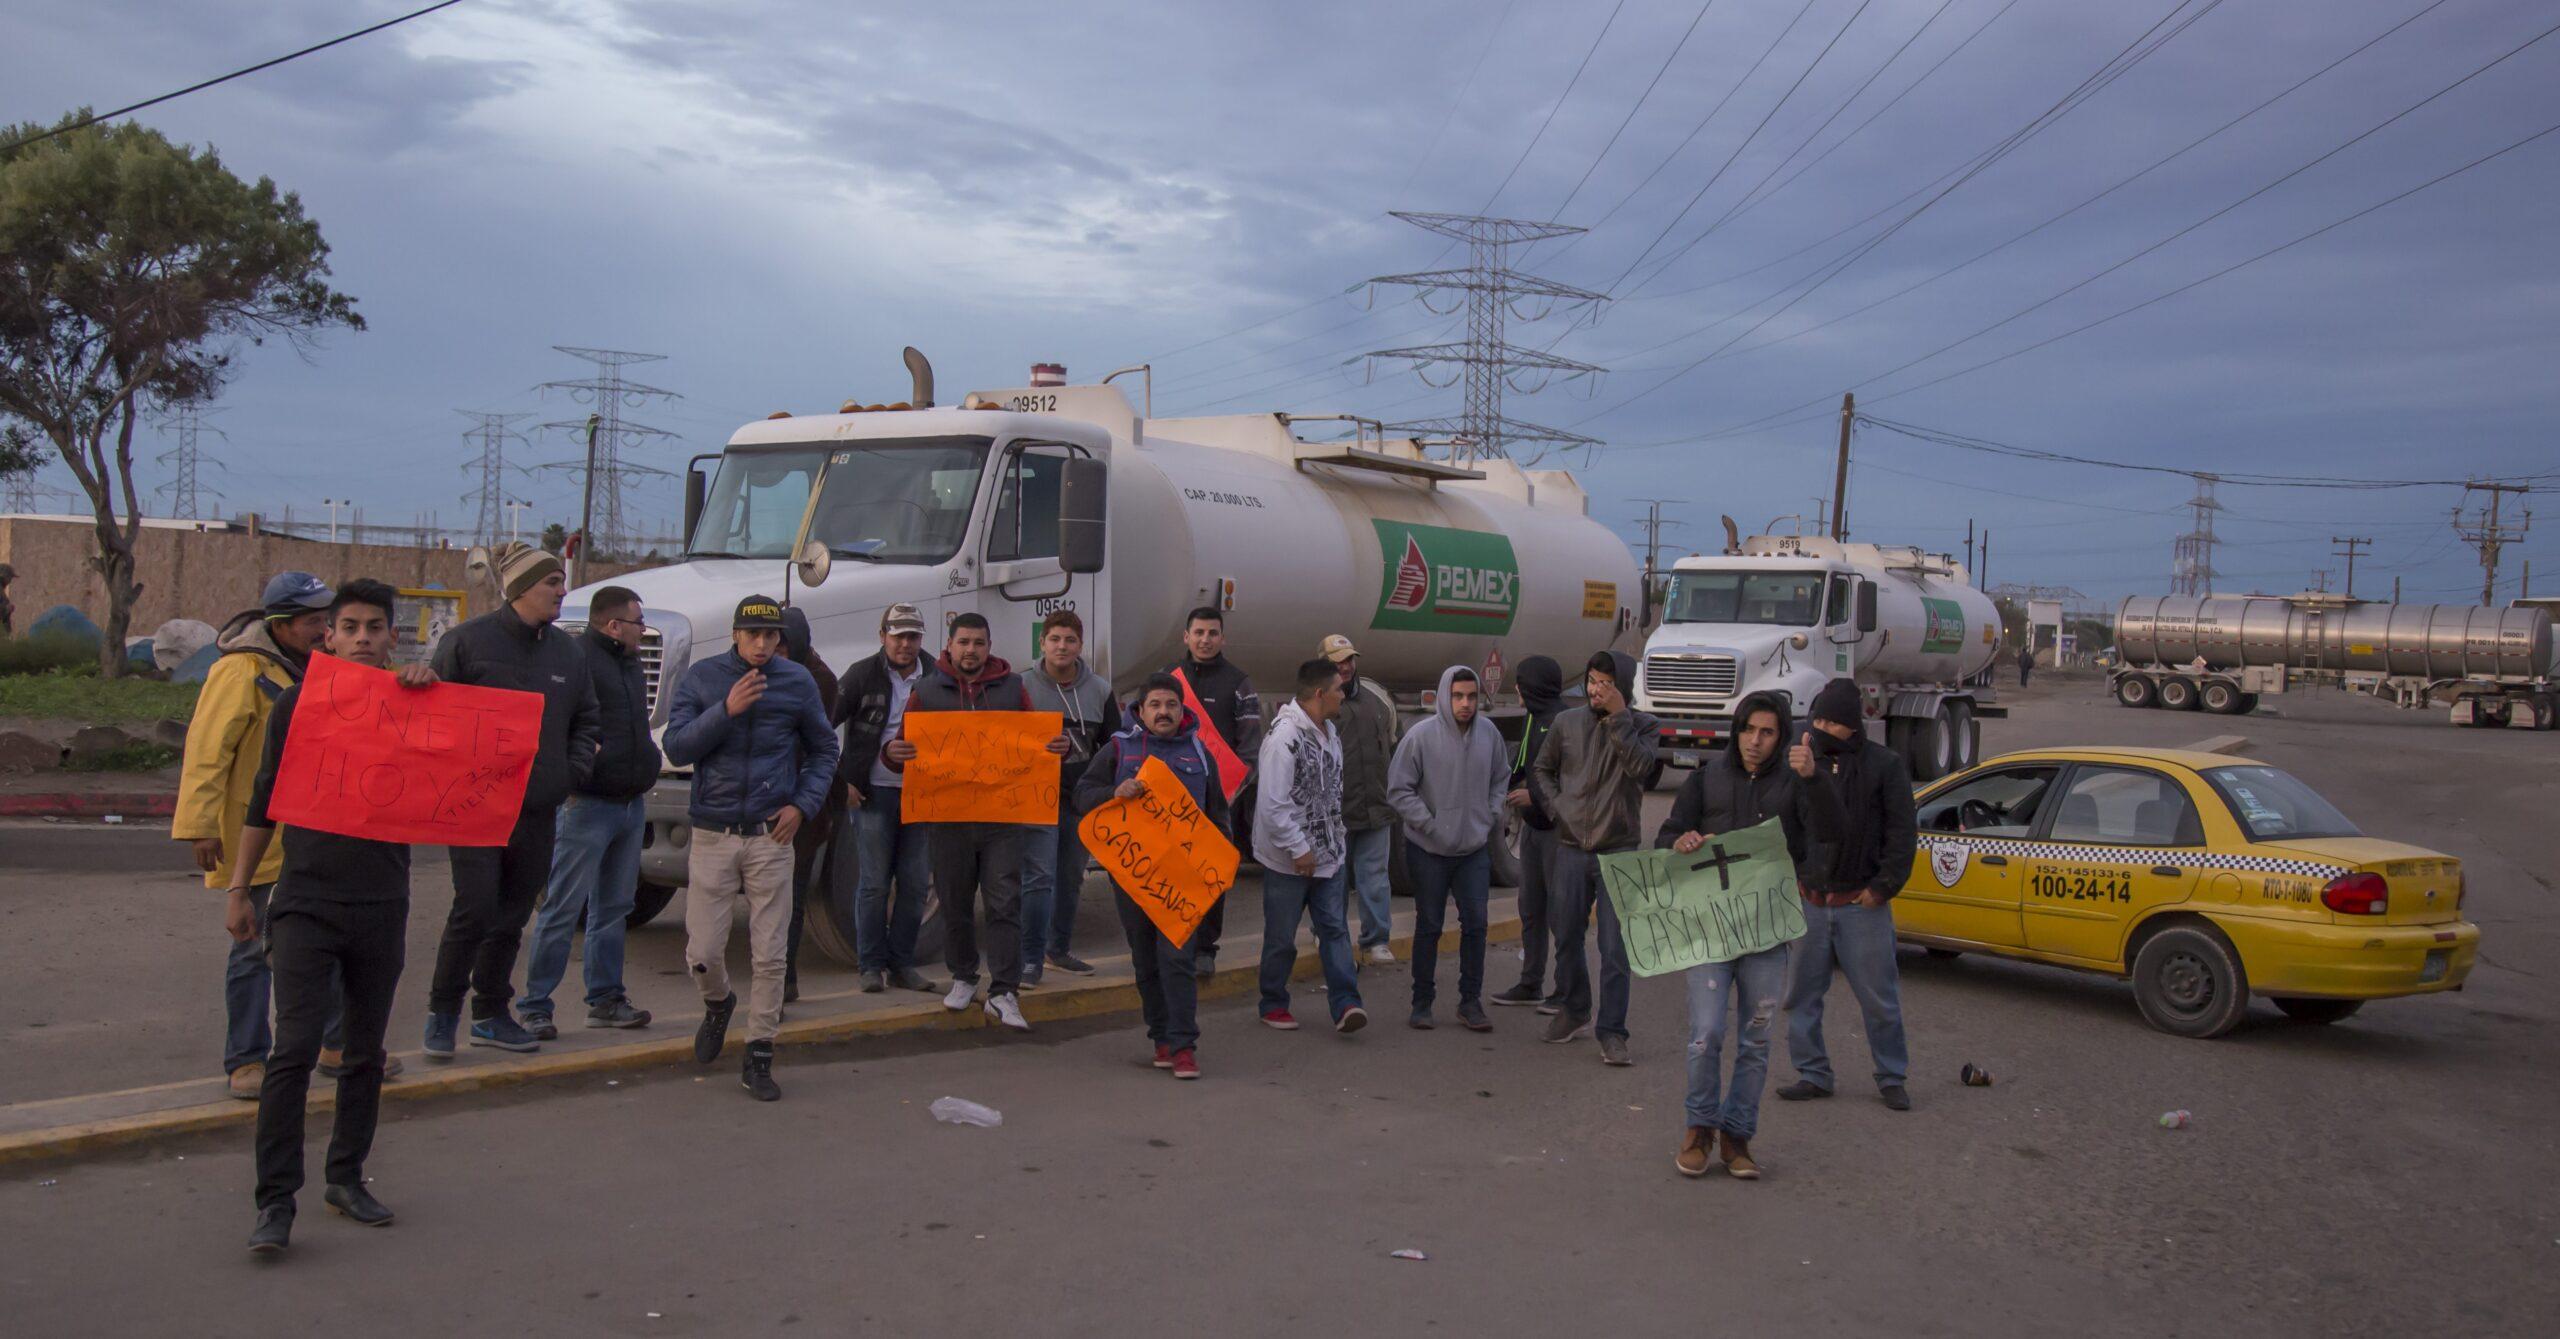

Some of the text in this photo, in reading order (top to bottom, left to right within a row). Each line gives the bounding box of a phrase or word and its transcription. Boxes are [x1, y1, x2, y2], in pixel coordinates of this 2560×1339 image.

[1436, 564, 1513, 603] PEMEX
[330, 670, 517, 758] UNETE
[315, 748, 459, 826] HOY
[1169, 793, 1200, 832] YA
[1611, 857, 1676, 910] NO
[2032, 874, 2131, 904] 100-24-14
[1627, 876, 1805, 970] GASOLINAZOS
